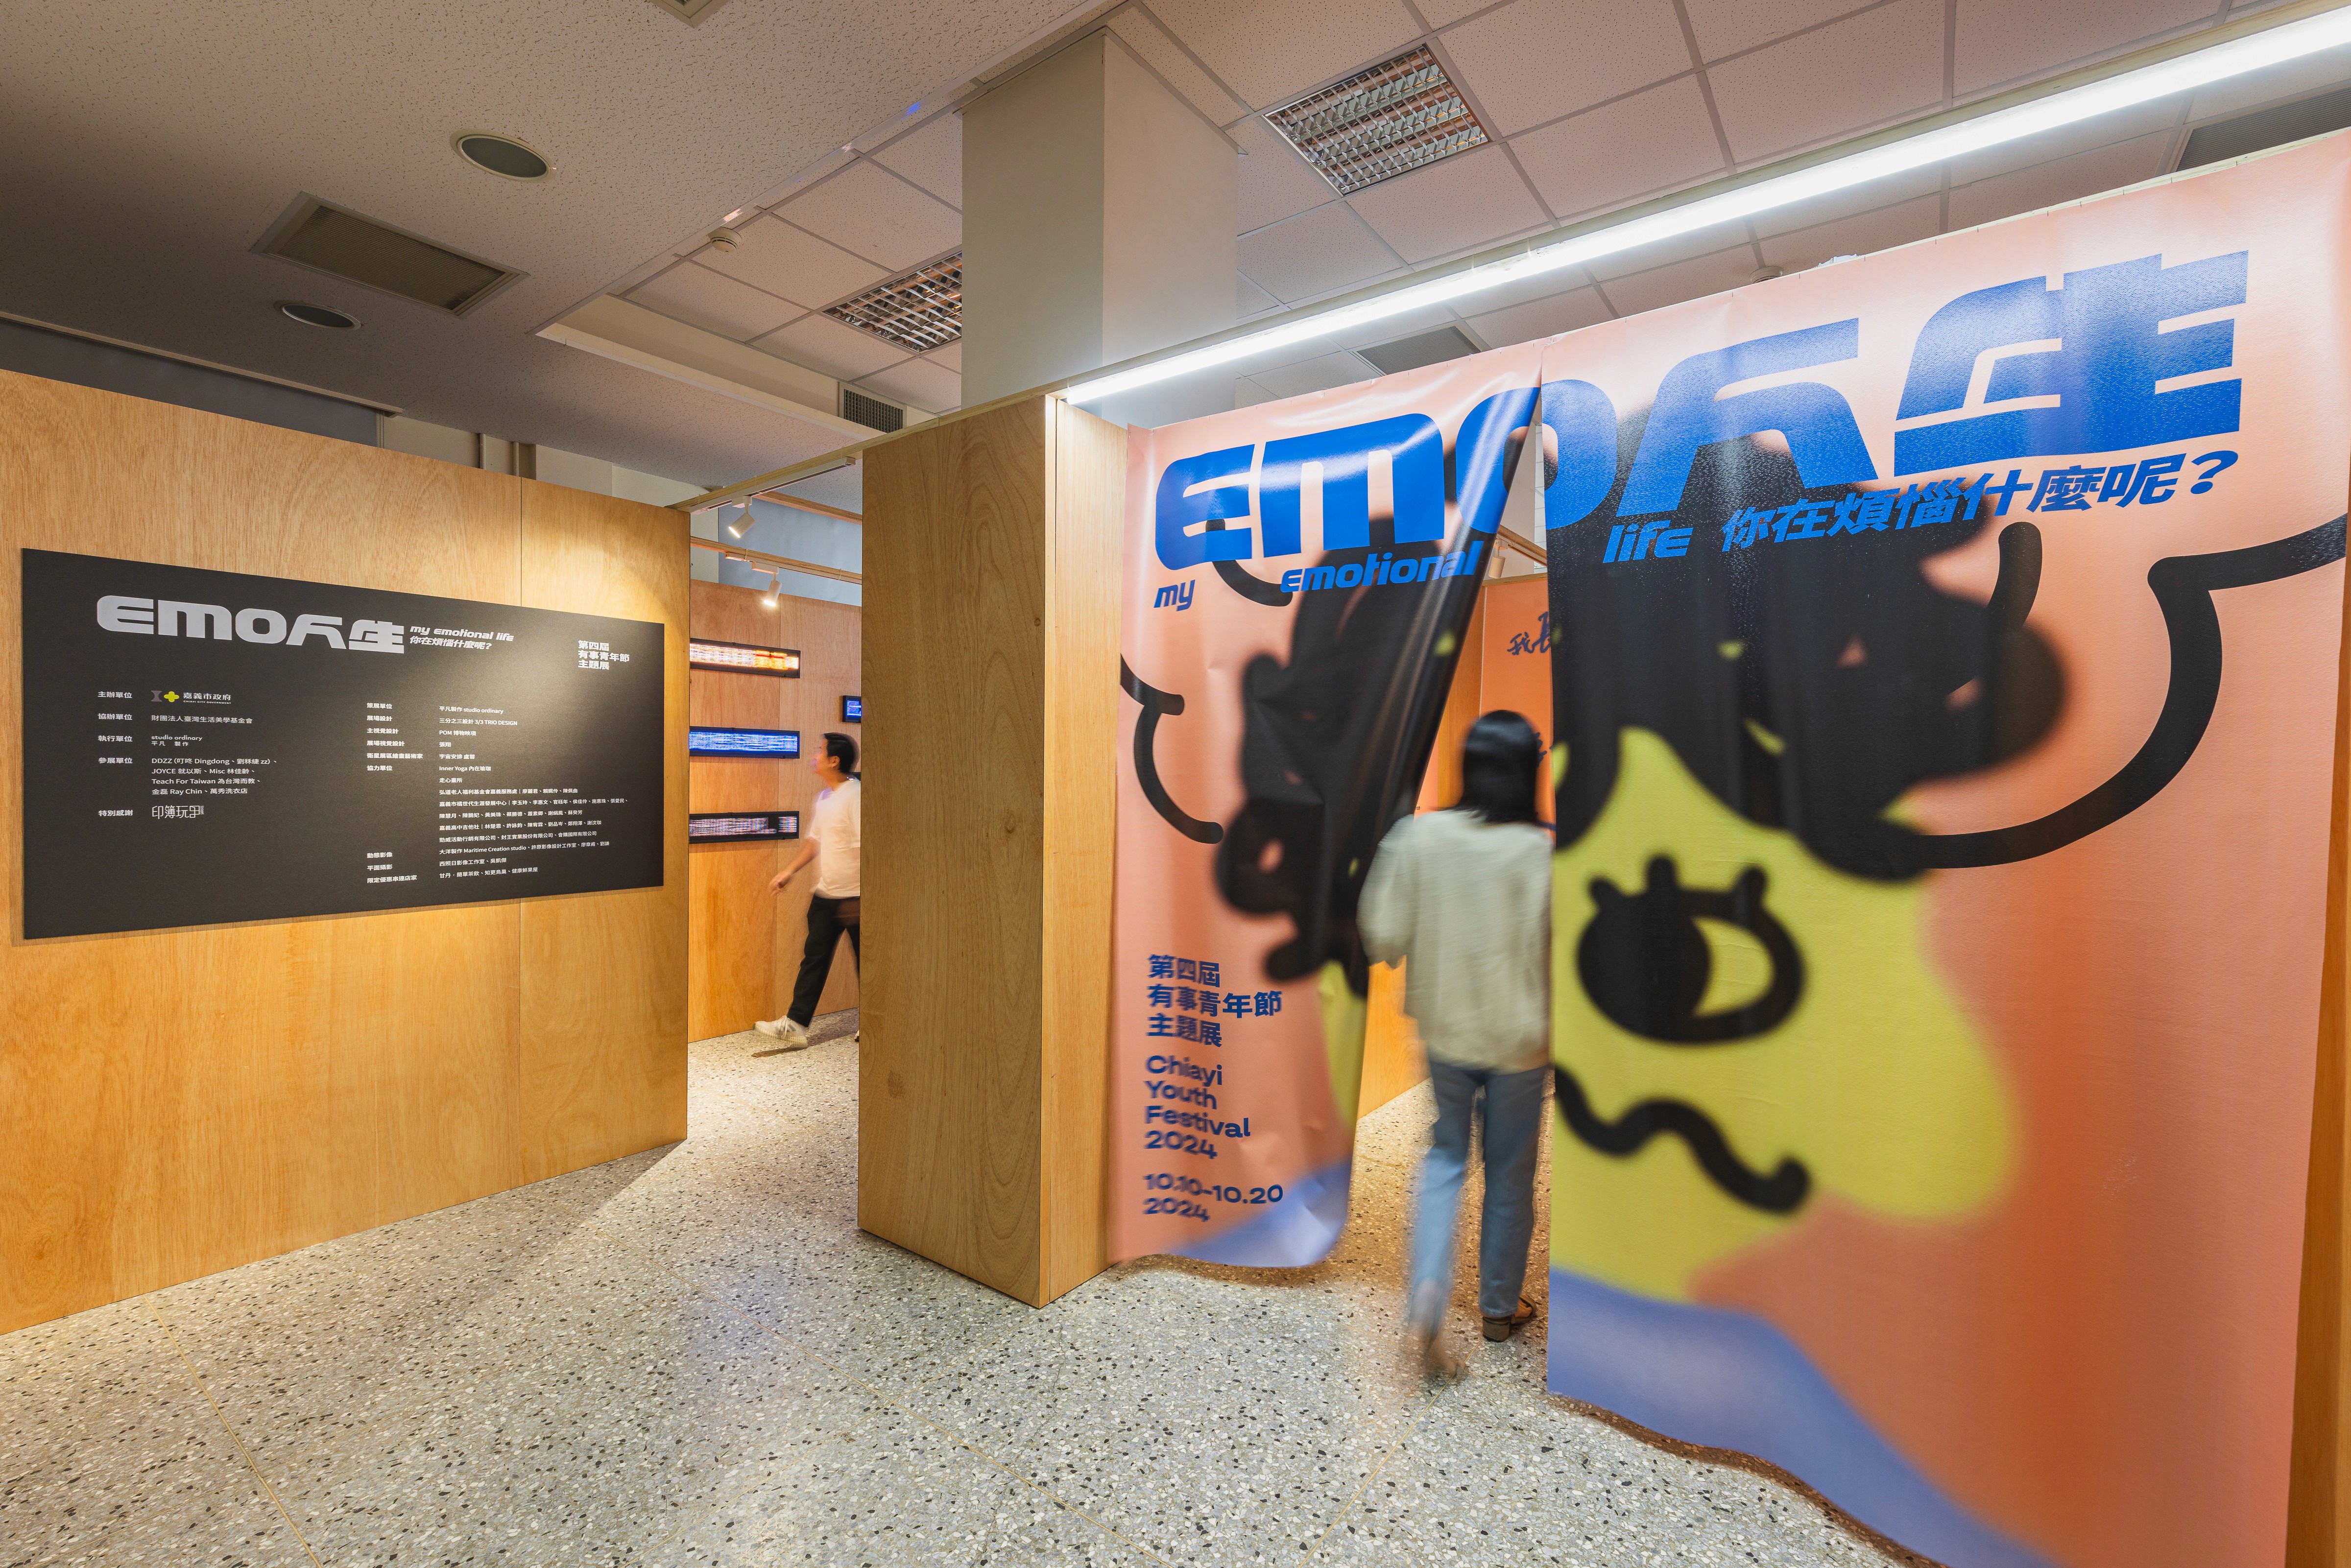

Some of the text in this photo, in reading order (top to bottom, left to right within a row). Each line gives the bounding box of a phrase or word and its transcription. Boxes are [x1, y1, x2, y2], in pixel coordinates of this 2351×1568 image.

[1153, 579, 1196, 612] my
[1279, 540, 1484, 594] emotional
[1603, 518, 1692, 564] life
[409, 626, 514, 641] my emotional life
[577, 640, 609, 654] 第四屆
[577, 650, 630, 664] 有事青年節
[577, 659, 610, 670] 主題展
[183, 692, 231, 701] 嘉義市政府
[151, 714, 253, 724] 財團法人臺灣生活美學基金會
[367, 875, 417, 884] 限定優惠串連店家
[1147, 954, 1221, 988] 第四屆
[1147, 984, 1282, 1019] 有事青年節
[1147, 1013, 1222, 1048] 主題展
[1146, 1055, 1223, 1087] Chiayi
[1144, 1081, 1217, 1110] Youth
[1145, 1105, 1251, 1139] Festival
[1144, 1130, 1218, 1159] 2024
[1143, 1173, 1283, 1205] 10.10-10.20
[1143, 1197, 1210, 1223] 2024
